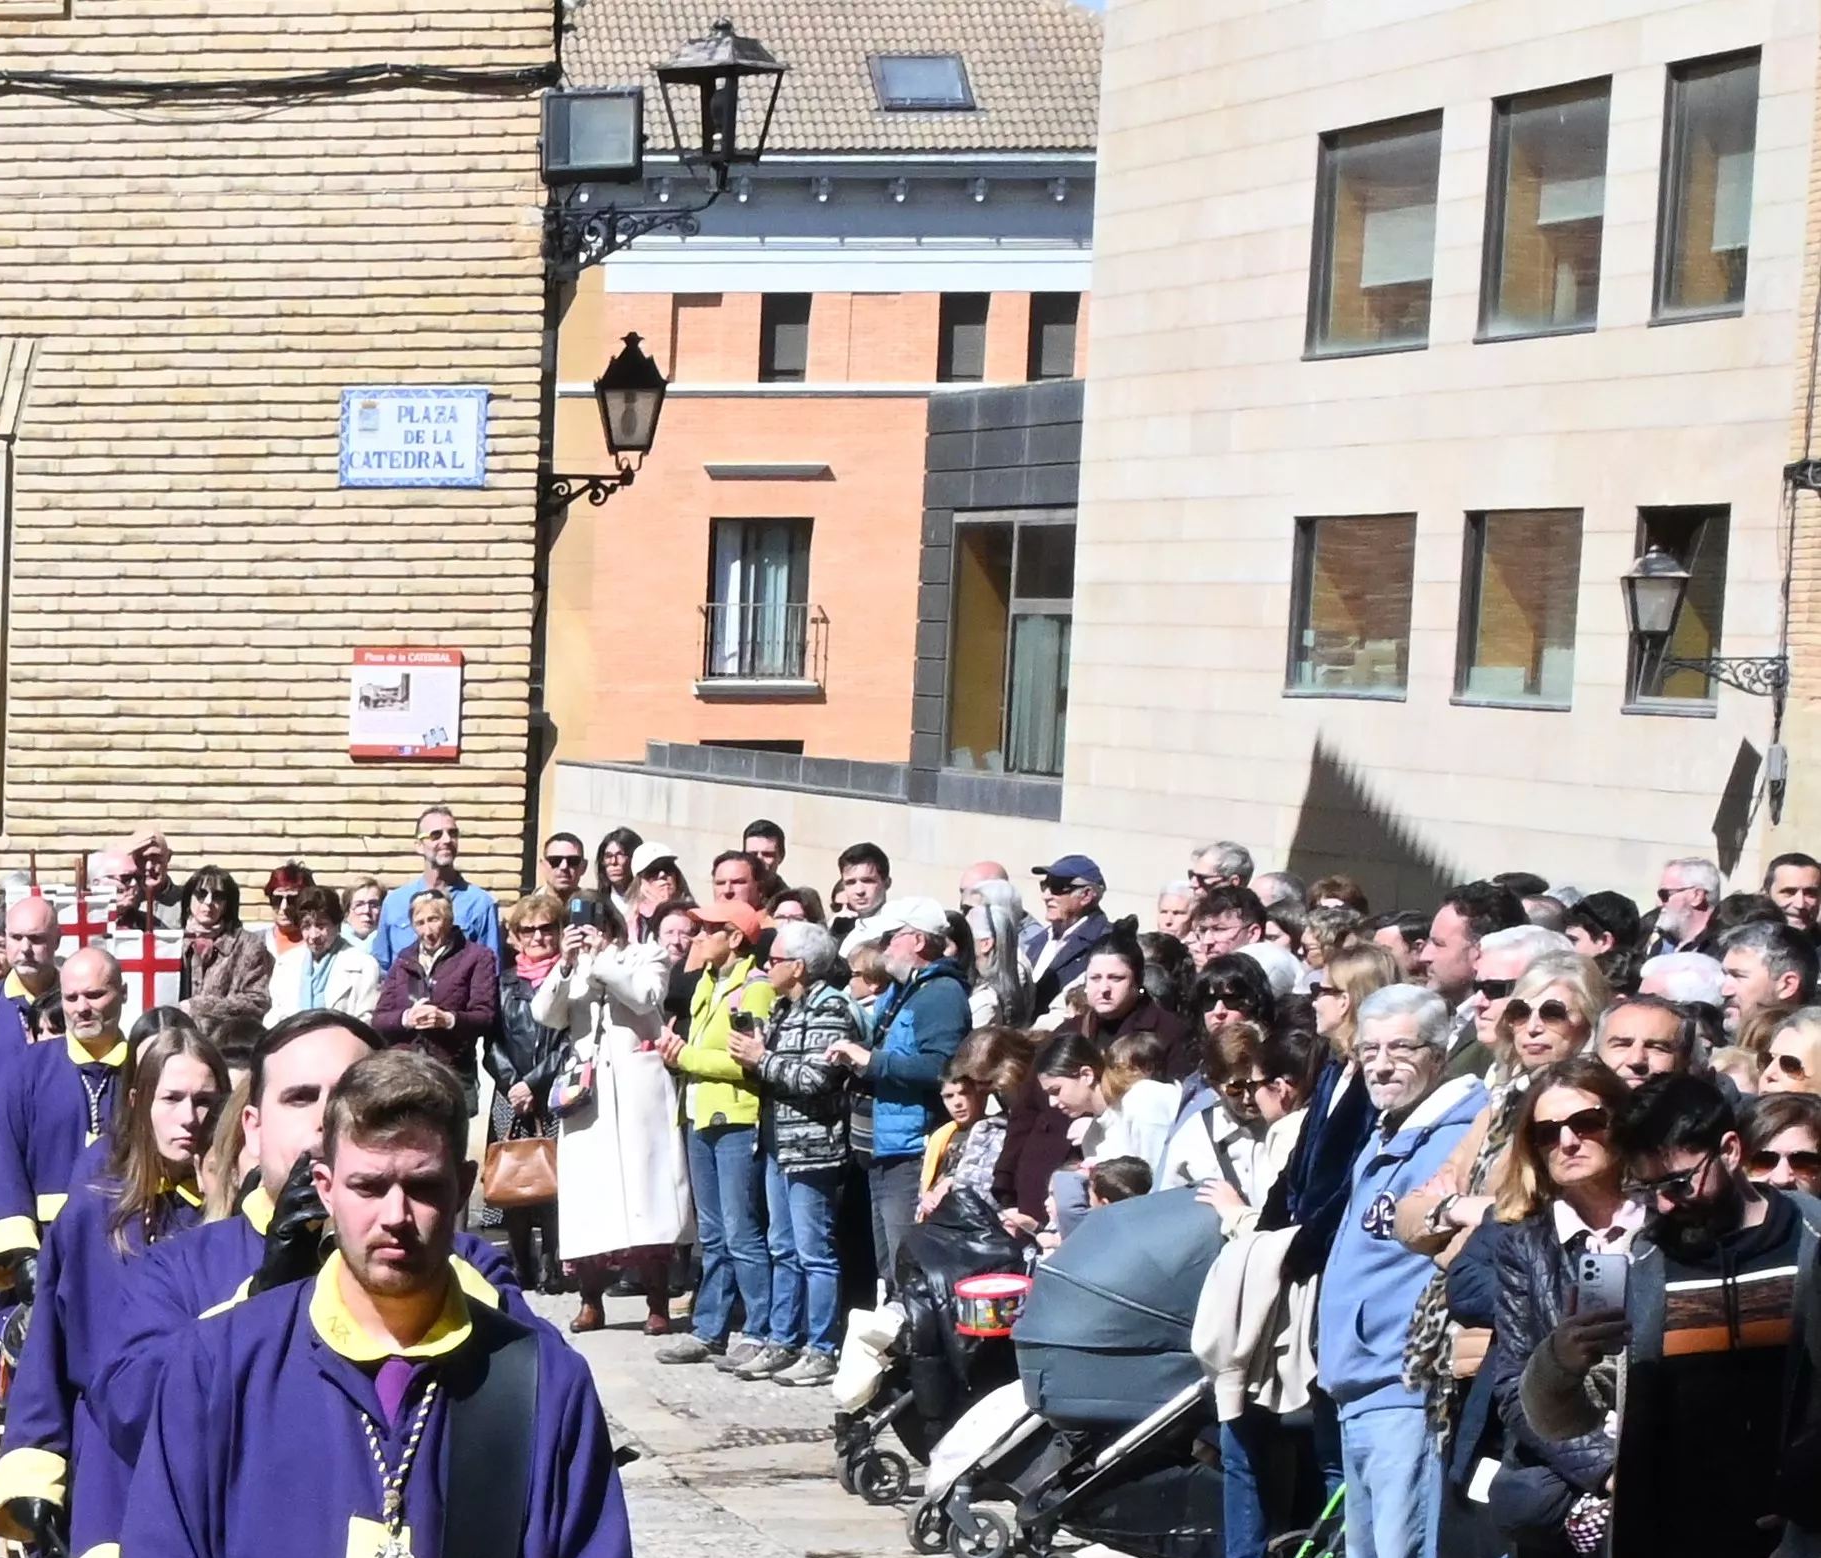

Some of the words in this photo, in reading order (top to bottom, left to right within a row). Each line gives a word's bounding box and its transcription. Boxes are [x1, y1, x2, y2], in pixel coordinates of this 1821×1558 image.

[397, 405, 459, 424] PLAZA
[403, 430, 426, 445] DE
[433, 430, 453, 445] LA
[349, 451, 465, 469] CATEDRAL
